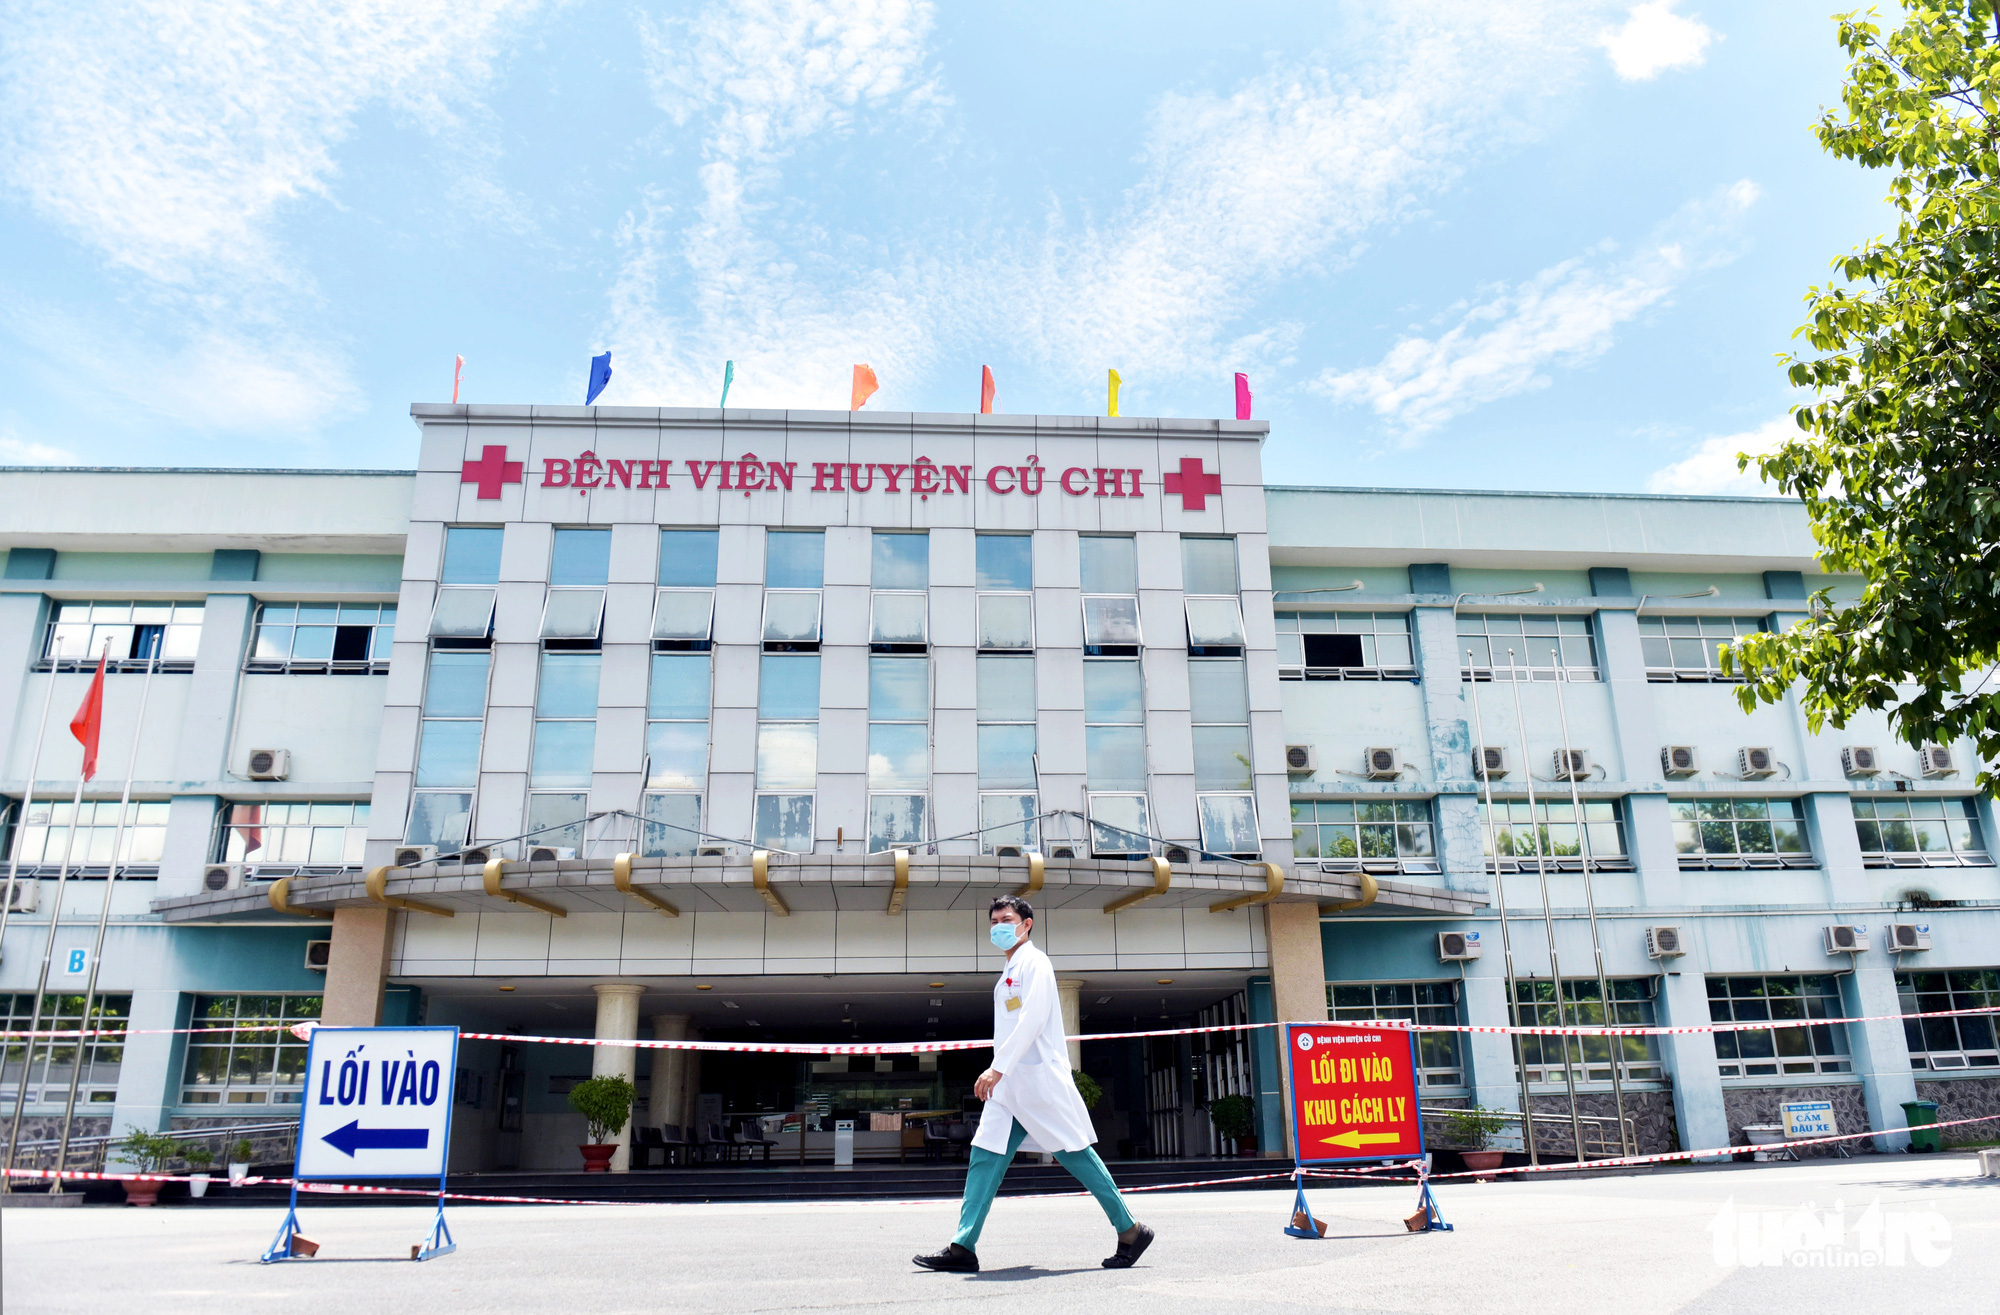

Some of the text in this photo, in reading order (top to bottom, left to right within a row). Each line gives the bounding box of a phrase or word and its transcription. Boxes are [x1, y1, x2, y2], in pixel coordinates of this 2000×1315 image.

[541, 449, 1145, 502] BỆNH VIỆN HUYỆN CỦ CHI
[68, 949, 86, 973] B
[1316, 1035, 1332, 1045] BỆNH
[1332, 1034, 1345, 1045] VIỆN
[1345, 1034, 1363, 1044] HUYỆN
[1372, 1034, 1382, 1043] CHI
[319, 1045, 440, 1106] LỐI VÀO
[1310, 1051, 1393, 1084] LỐI ĐI VÀO
[1303, 1093, 1406, 1126] KHU CÁCH LY
[1796, 1111, 1821, 1122] CẤM
[1791, 1123, 1830, 1135] ĐẬU XE
